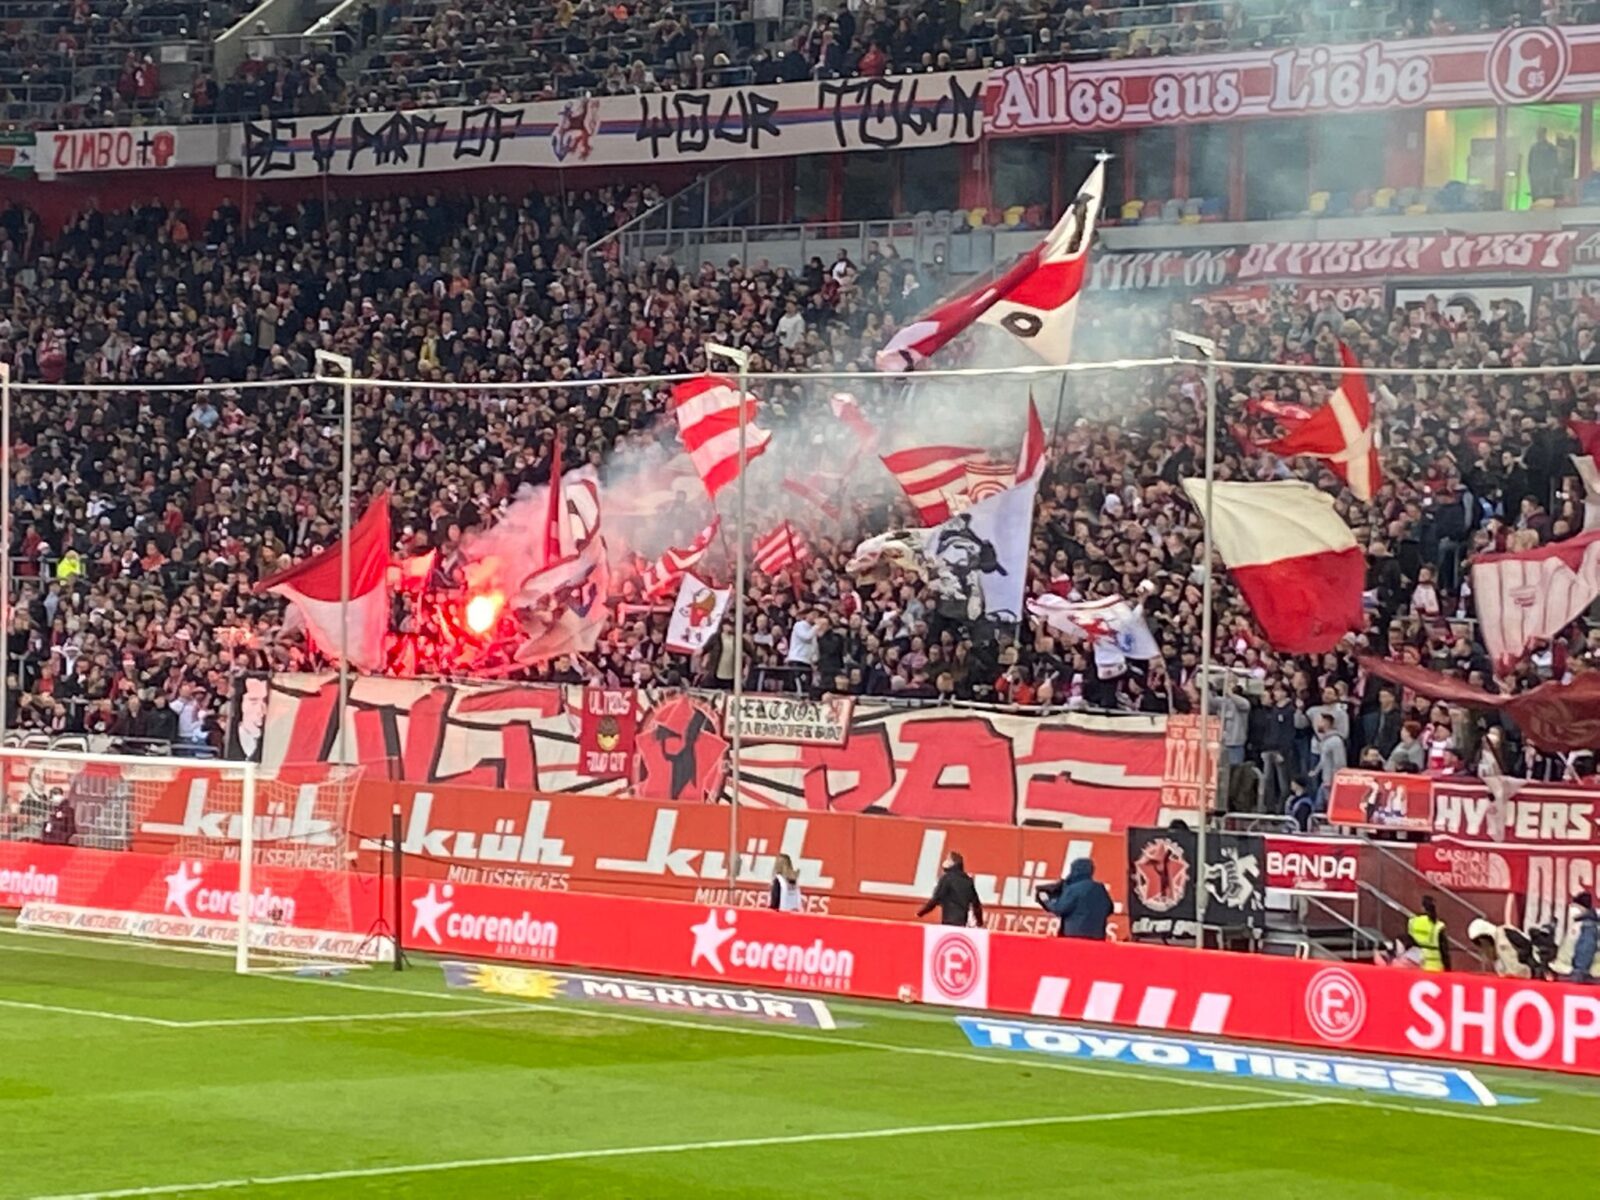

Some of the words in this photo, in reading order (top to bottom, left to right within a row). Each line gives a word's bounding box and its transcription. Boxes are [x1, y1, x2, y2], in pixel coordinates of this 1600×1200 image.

[994, 64, 1125, 128] Alles
[1150, 69, 1240, 120] aus
[1267, 43, 1432, 110] Liebe
[636, 90, 781, 158] YOUR
[53, 131, 132, 170] ZIMBO
[1237, 238, 1435, 281] DIVISION
[1440, 231, 1580, 270] WEST
[448, 864, 571, 892] MULTISERVICES
[1266, 851, 1358, 880] BANDA
[196, 887, 296, 927] coredon
[694, 887, 831, 915] MULTISECES
[446, 911, 559, 947] corendon
[729, 938, 854, 978] corendon
[580, 979, 798, 1019] MERKUR
[784, 974, 850, 991] AIRLINES
[1404, 979, 1600, 1065] SHOP
[976, 1023, 1191, 1064] TOYO
[1198, 1048, 1450, 1097] TIRES
